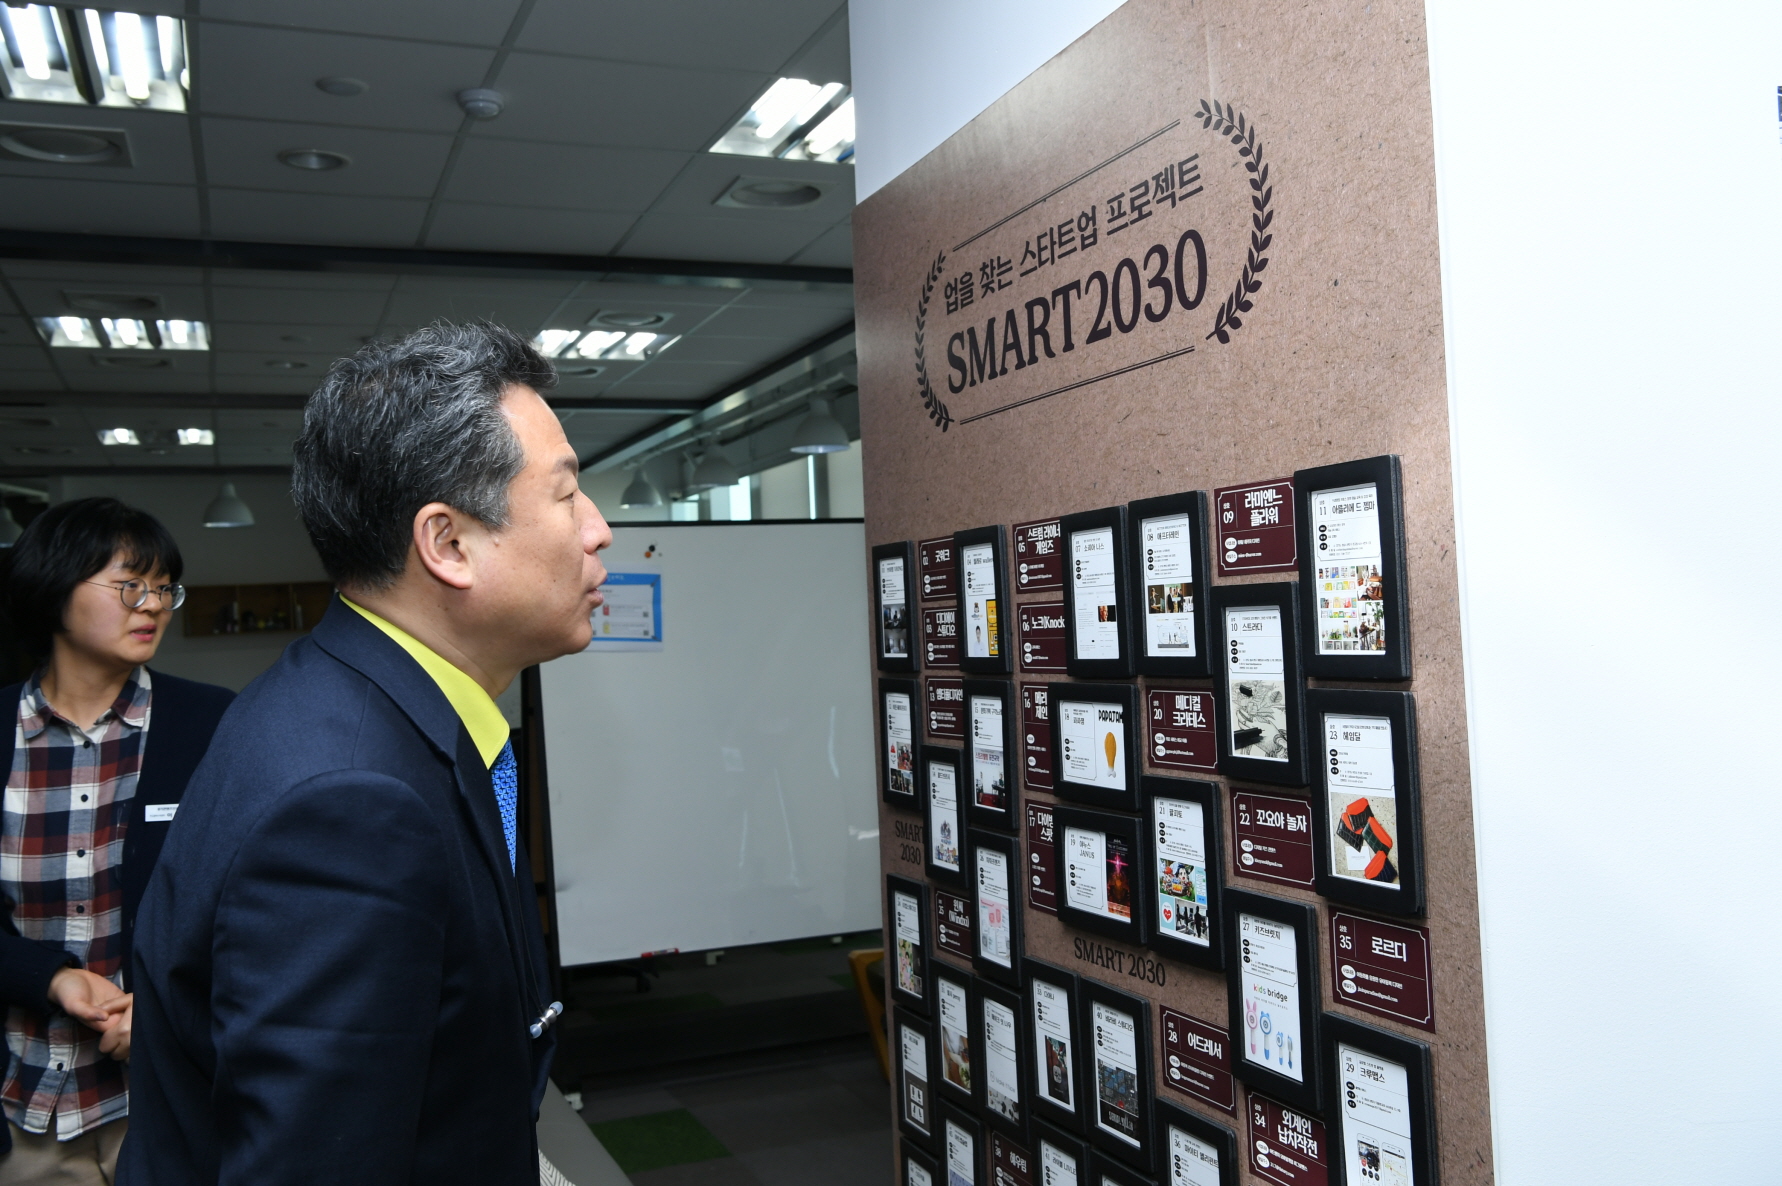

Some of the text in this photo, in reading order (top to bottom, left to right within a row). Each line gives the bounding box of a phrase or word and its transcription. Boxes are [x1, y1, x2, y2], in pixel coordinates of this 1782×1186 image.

[943, 153, 1204, 316] 업을 찾는 스타트업 프로젝트
[1245, 488, 1284, 509] 라미엔느
[1223, 511, 1234, 524] 09
[1250, 507, 1279, 527] 플라워
[1319, 506, 1327, 516] 11
[1147, 533, 1154, 542] 08
[1018, 542, 1026, 553] 05
[1035, 541, 1055, 555] 게임즈
[922, 556, 929, 566] 02
[936, 624, 956, 637] 스튜디오
[1022, 621, 1030, 632] 06
[1230, 623, 1238, 632] 10
[1024, 698, 1031, 709] 16
[1175, 695, 1201, 712] 메디컬
[1153, 709, 1163, 720] 20
[1172, 711, 1207, 728] 크라테스
[1329, 730, 1338, 740] 23
[1159, 806, 1166, 815] 21
[1029, 816, 1036, 827] 17
[1239, 812, 1250, 826] 22
[1256, 809, 1308, 833] 꼬요야 놀자
[1070, 838, 1076, 846] 19
[900, 842, 922, 866] 2030
[1079, 848, 1095, 860] JANUS
[1243, 922, 1250, 932] 27
[1339, 934, 1352, 950] 35
[1371, 936, 1407, 962] 로르디
[1073, 936, 1166, 987] SMART 2030
[1253, 983, 1288, 1003] kids bridge
[1168, 1030, 1178, 1043] 28
[1187, 1032, 1222, 1060] 어드레서
[1345, 1063, 1355, 1073] 29
[1254, 1112, 1266, 1128] 34
[1281, 1109, 1312, 1137] 외계인
[1174, 1139, 1181, 1149] 36
[1277, 1125, 1319, 1159] 납치작전
